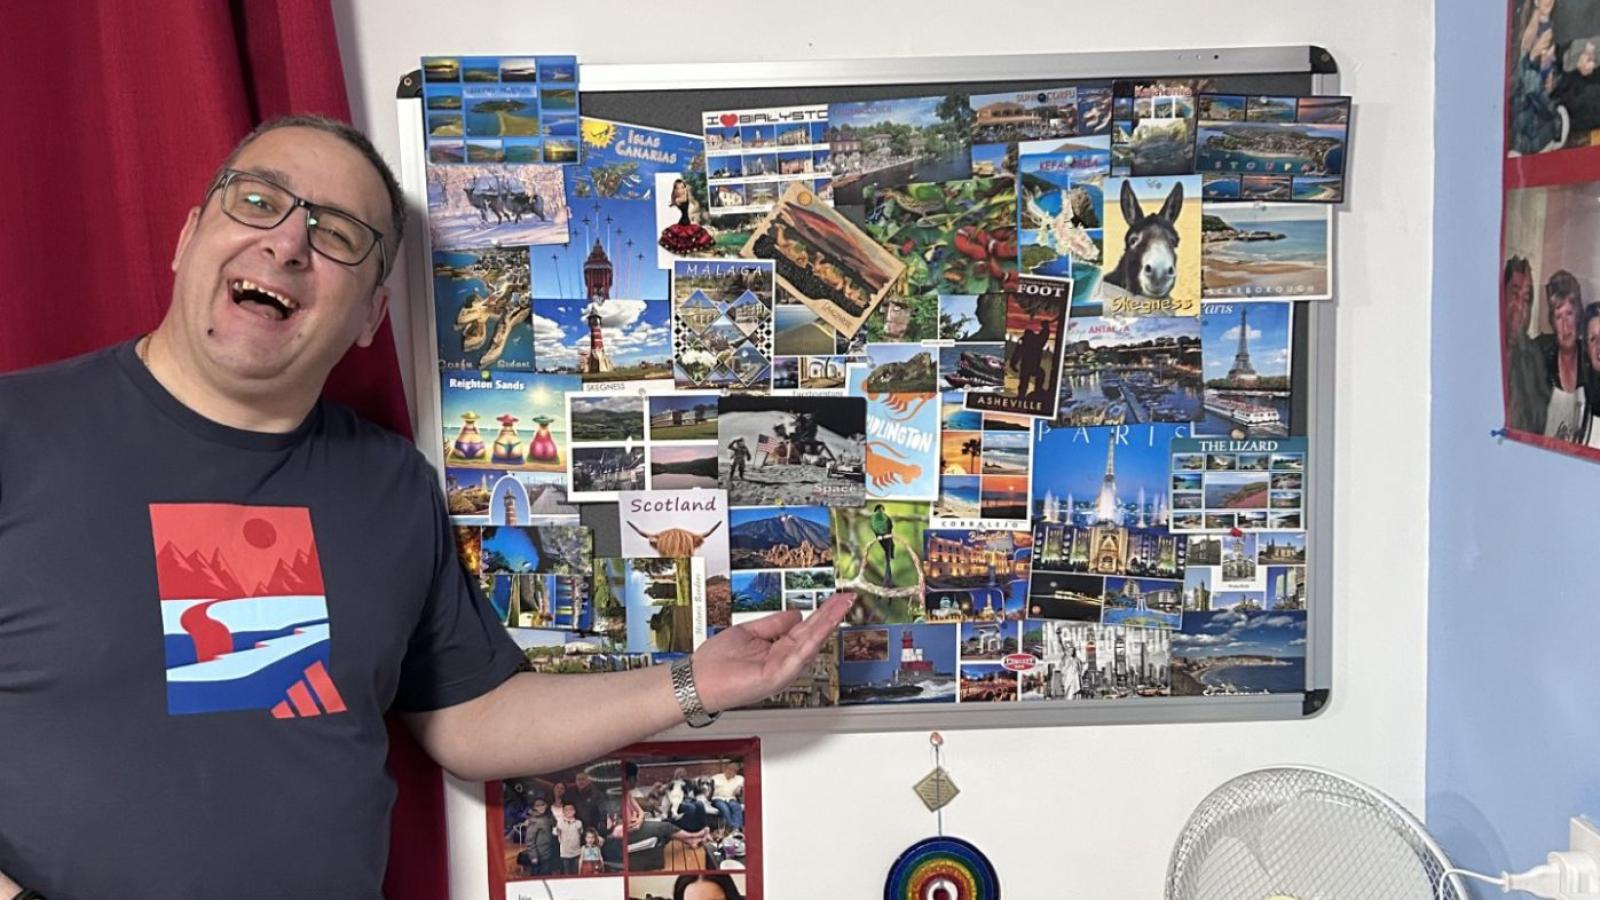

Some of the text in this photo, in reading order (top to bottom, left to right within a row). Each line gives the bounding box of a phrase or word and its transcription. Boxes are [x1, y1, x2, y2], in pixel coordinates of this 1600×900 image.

[706, 116, 719, 126] I
[615, 140, 678, 165] CANARIAS
[1214, 161, 1312, 173] STOUPA
[1017, 284, 1065, 298] FOOT
[1112, 297, 1193, 316] Skegness
[1202, 303, 1233, 315] aris
[449, 378, 527, 391] Reighton Sands
[585, 383, 626, 393] SKEGNESS
[976, 395, 1043, 412] ASHEVILLE
[867, 413, 934, 454] IDLINGTON
[1197, 440, 1278, 453] THE LIZARD
[811, 482, 860, 497] Space
[630, 496, 717, 514] Scotland
